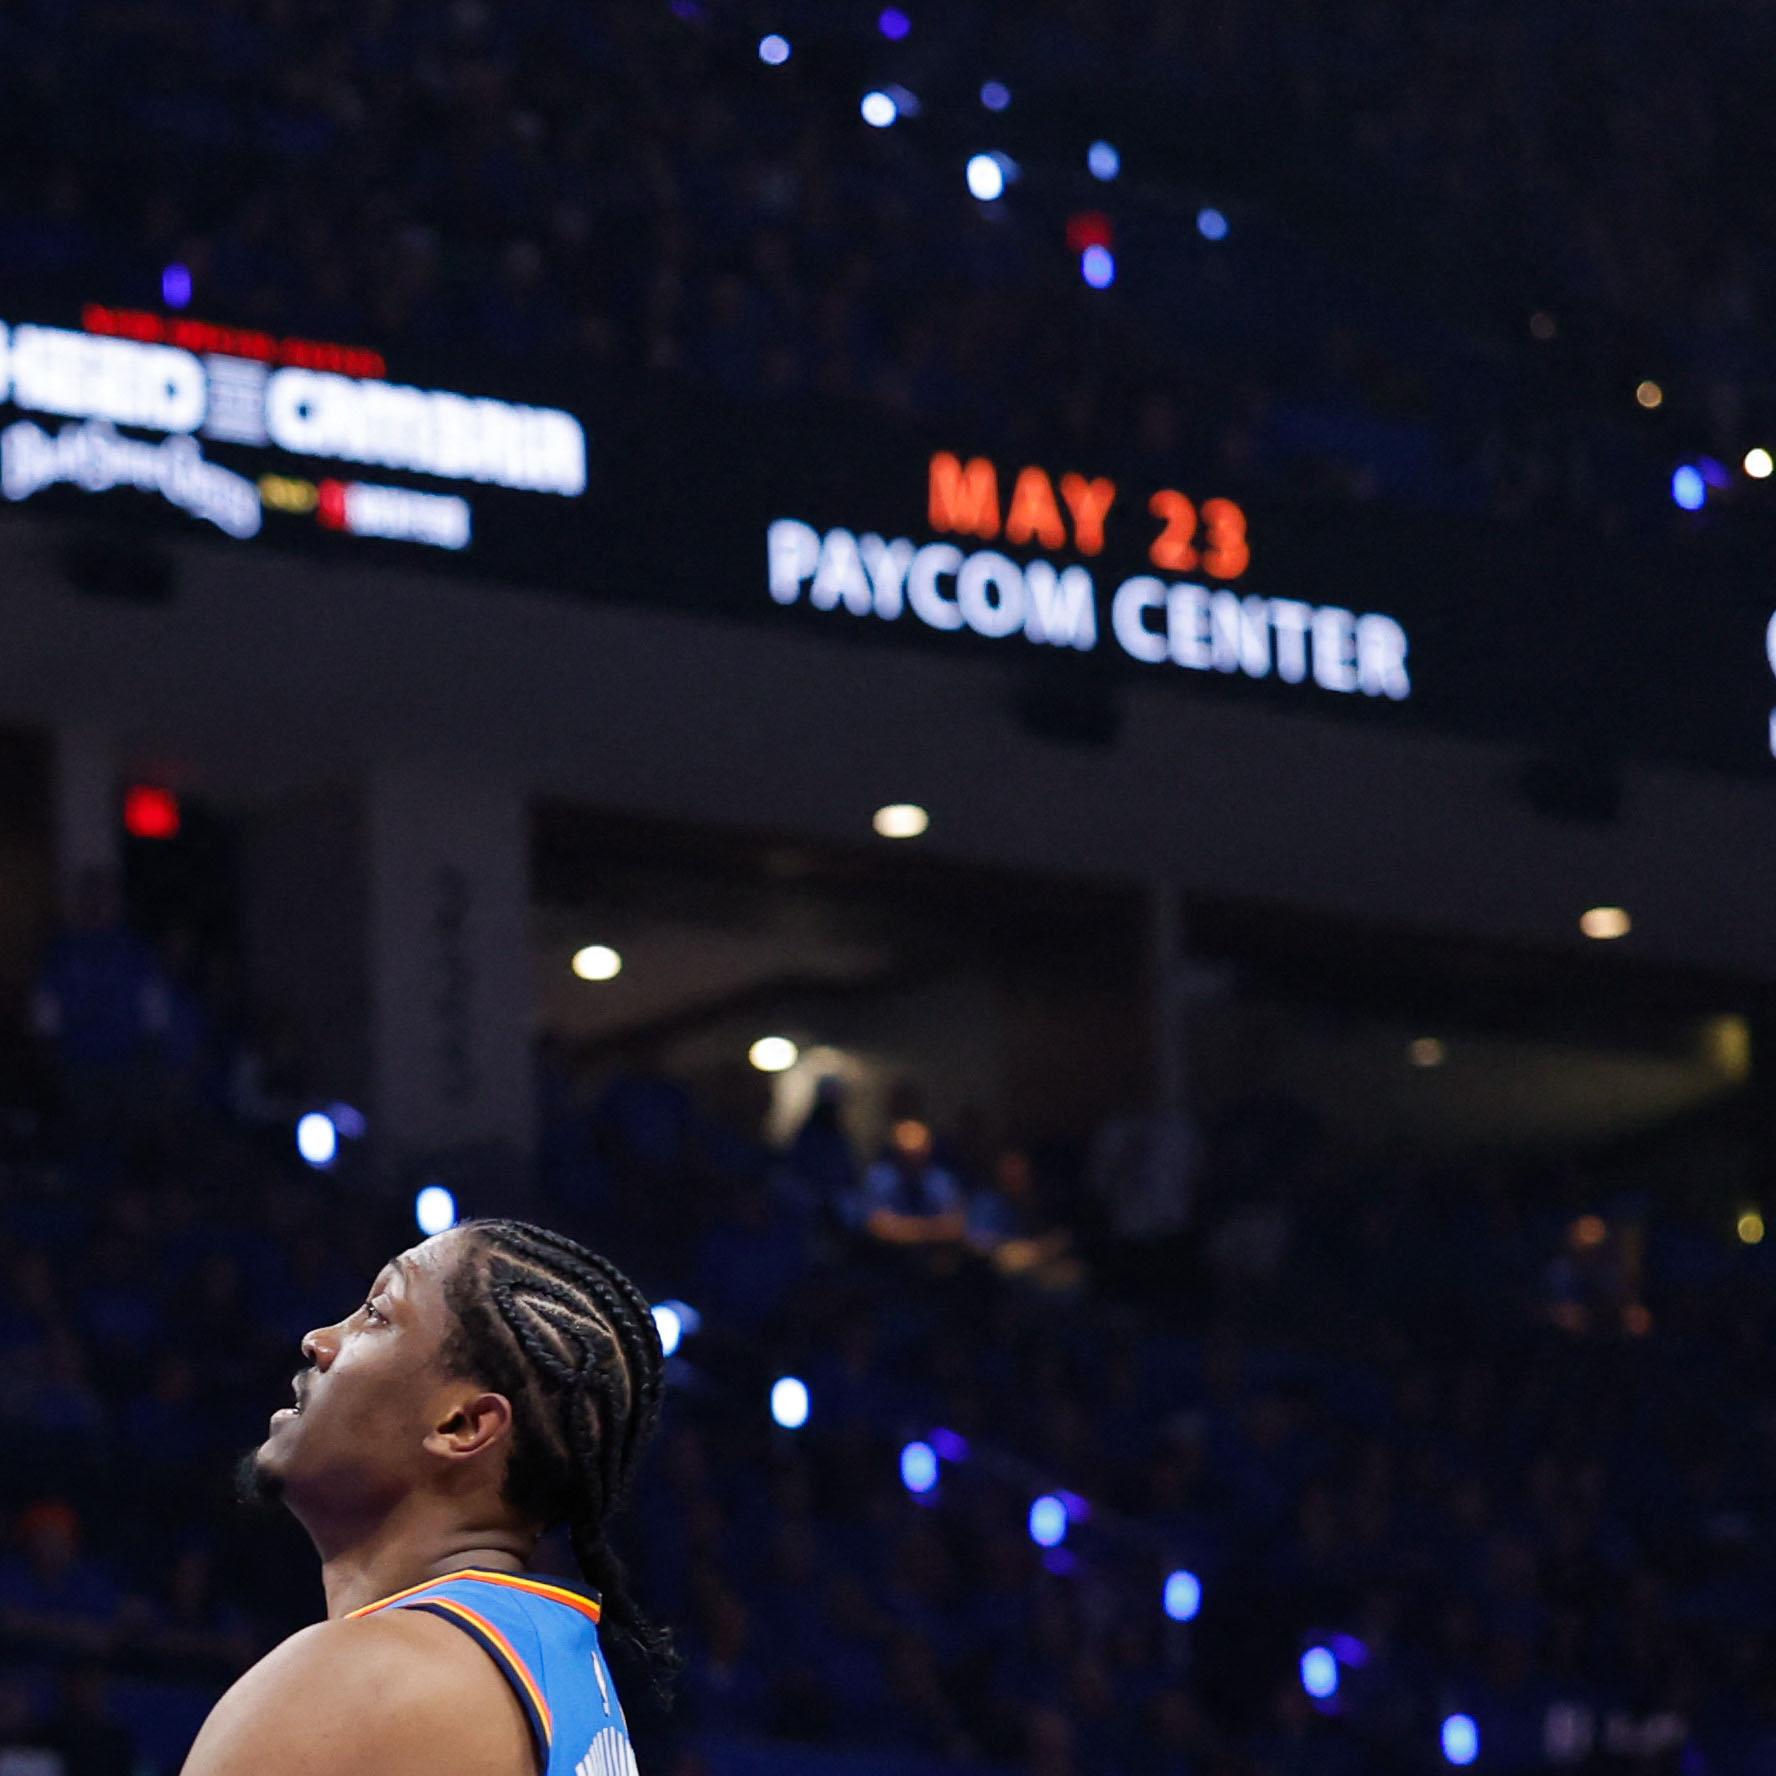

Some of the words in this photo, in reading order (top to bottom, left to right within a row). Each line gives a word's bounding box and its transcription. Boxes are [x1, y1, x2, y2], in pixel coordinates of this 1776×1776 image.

[928, 450, 1115, 556] MAY
[1148, 488, 1250, 580] 23
[767, 517, 1097, 652] PAYCOM
[1112, 575, 1410, 701] CENTER
